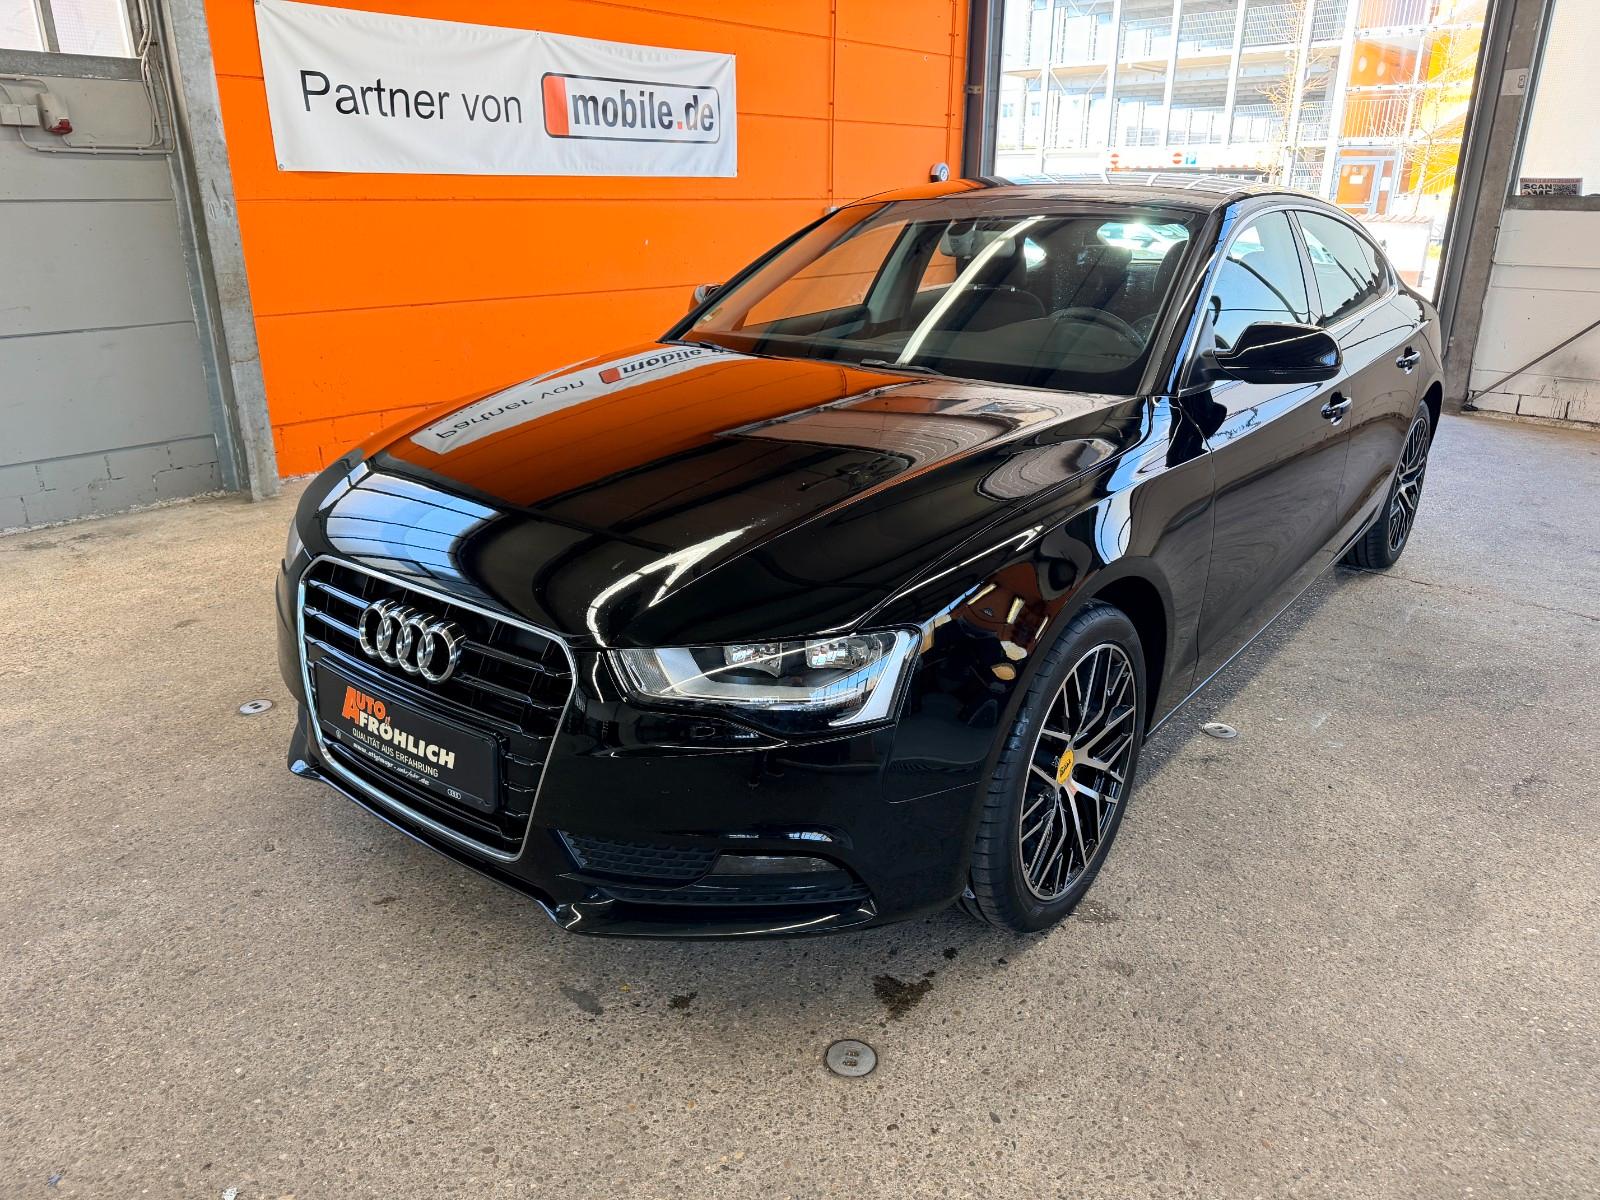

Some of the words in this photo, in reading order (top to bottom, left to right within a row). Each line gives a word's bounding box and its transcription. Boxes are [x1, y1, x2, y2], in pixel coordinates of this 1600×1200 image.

[299, 69, 450, 120] Partner
[461, 94, 522, 124] von
[571, 88, 715, 132] mobile.de
[341, 686, 386, 725] AUTO
[352, 727, 380, 750] QUALITÄT
[381, 743, 395, 757] AUS
[395, 751, 439, 778] ERFAHRUNG
[359, 711, 456, 770] FRÖHLICH
